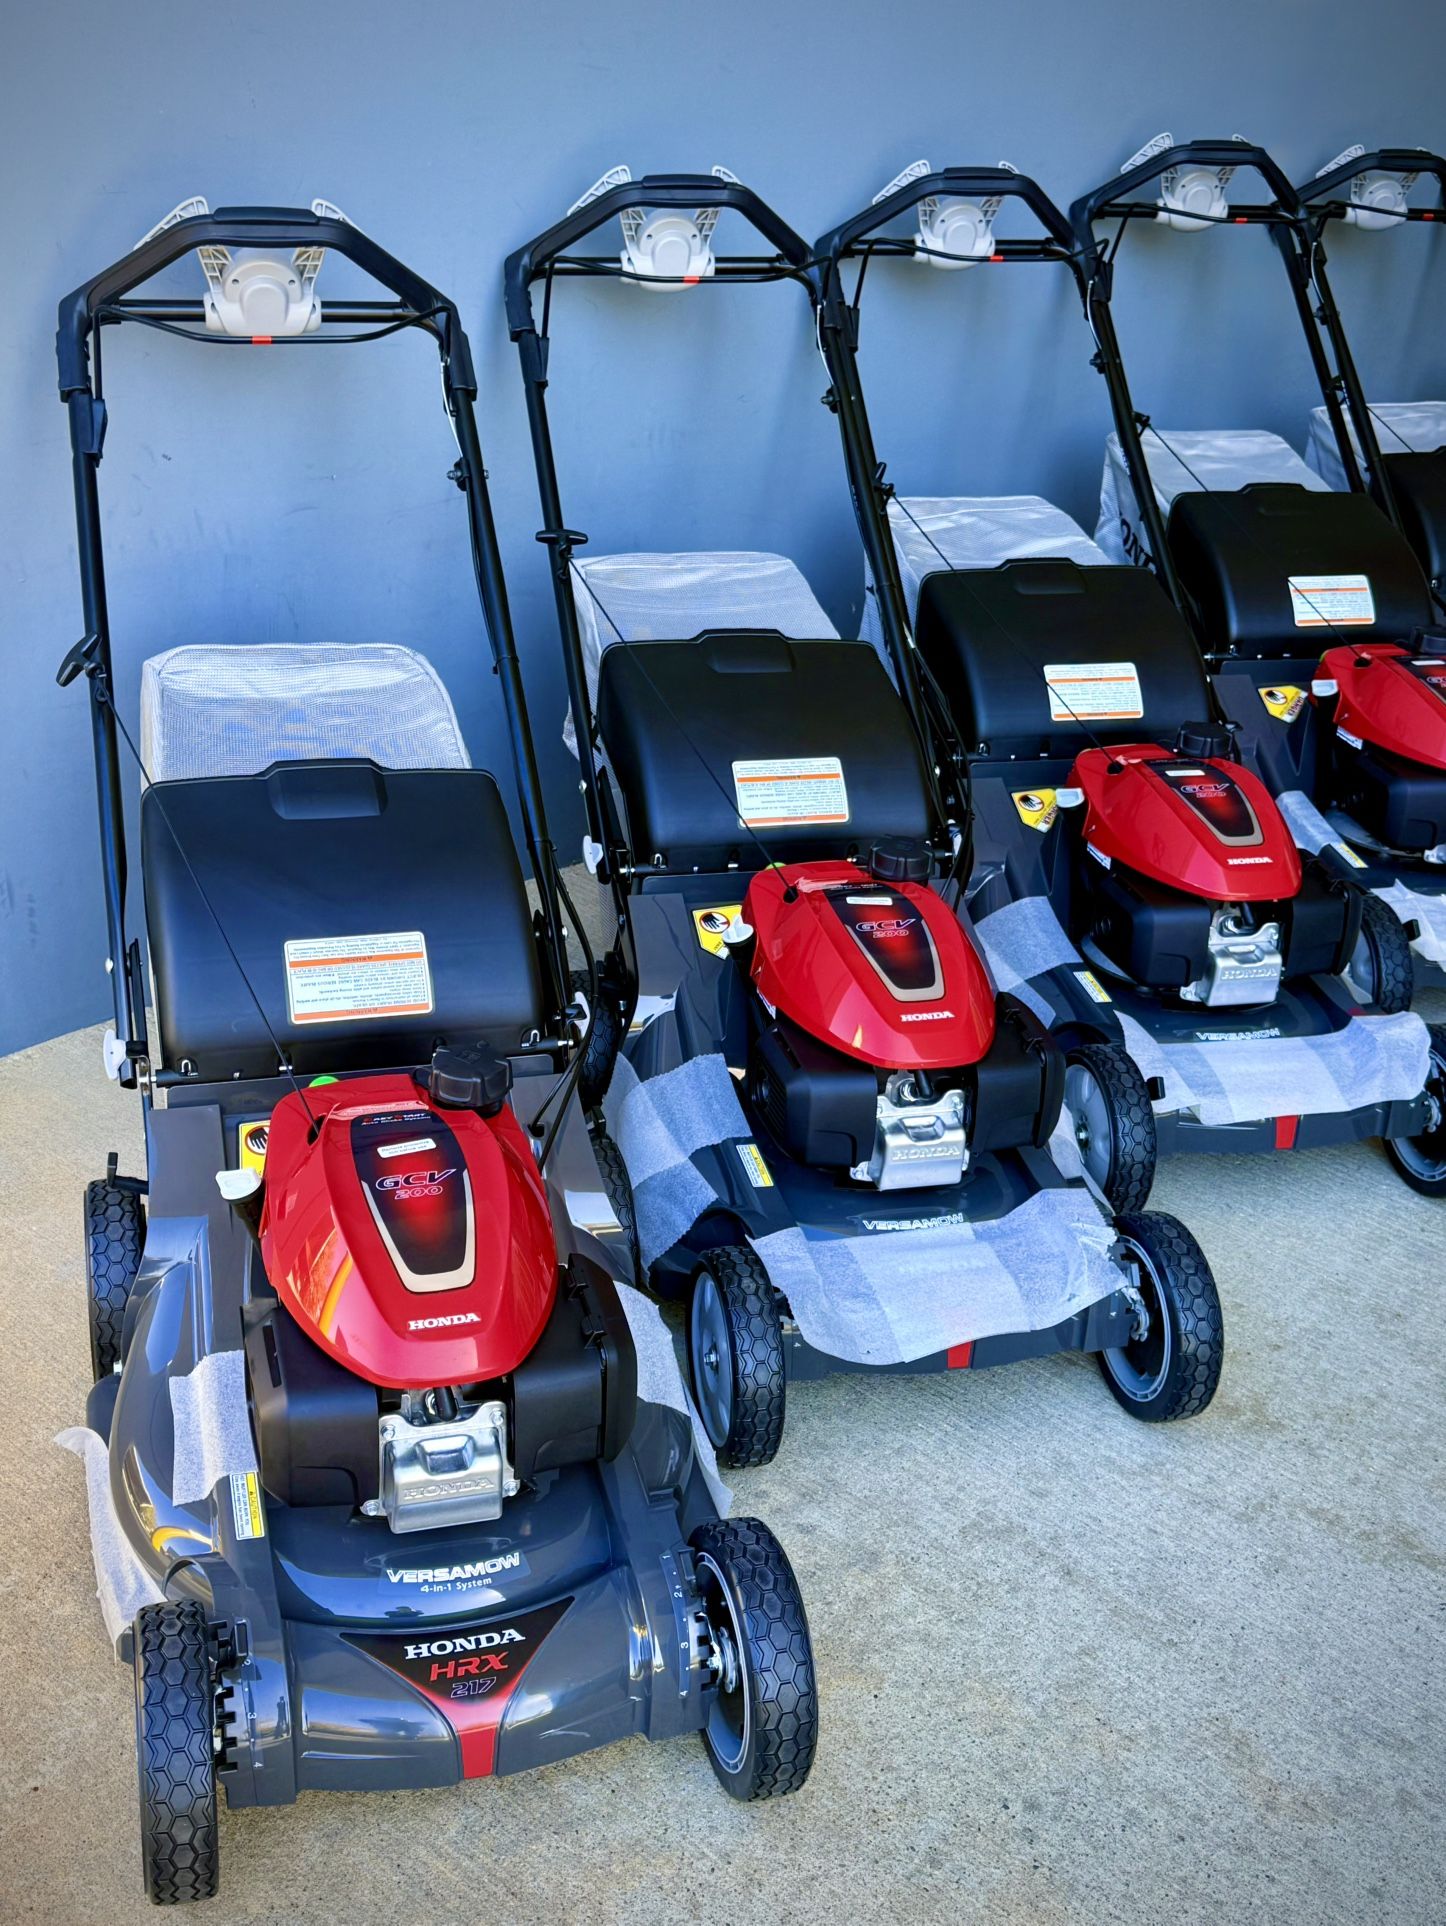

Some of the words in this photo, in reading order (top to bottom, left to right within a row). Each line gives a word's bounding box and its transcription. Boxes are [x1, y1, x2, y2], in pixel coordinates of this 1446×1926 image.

[1227, 857, 1274, 865] HONDA
[856, 918, 916, 932] GCV
[872, 929, 909, 939] 200
[1221, 967, 1278, 980] HONDA
[900, 1011, 955, 1022] HONDA
[892, 1146, 960, 1161] HONDA
[376, 1168, 457, 1191] GCV
[394, 1186, 443, 1200] 200
[862, 1212, 964, 1231] VERSAMOW
[408, 1312, 481, 1331] HONDA
[403, 1477, 495, 1500] HONDA
[386, 1552, 521, 1584] VERSAMOW
[420, 1582, 452, 1593] 4-in-1
[456, 1577, 493, 1592] System
[404, 1628, 526, 1660] HONDA
[429, 1651, 509, 1682] HRX
[450, 1677, 497, 1699] 217
